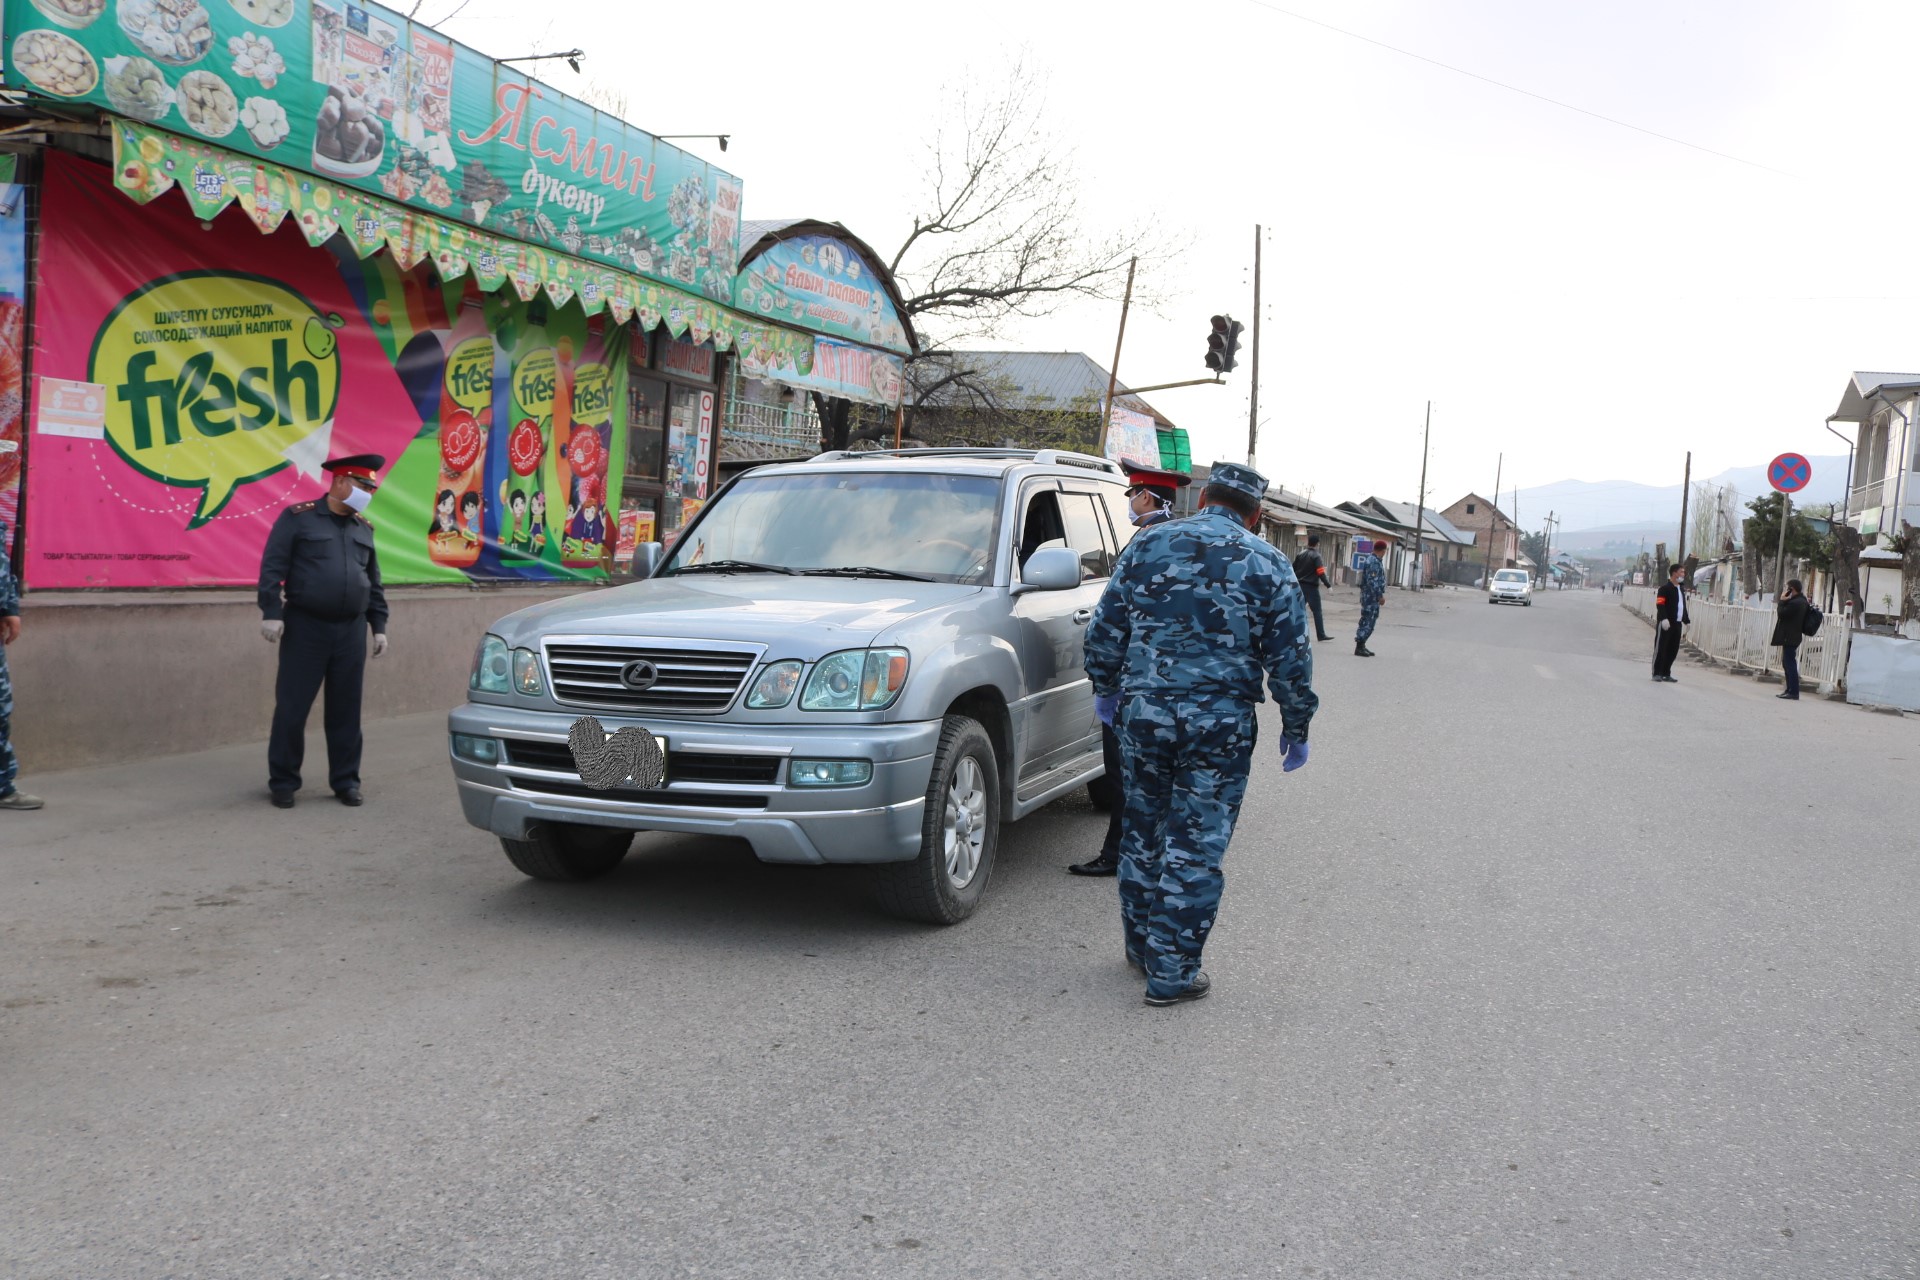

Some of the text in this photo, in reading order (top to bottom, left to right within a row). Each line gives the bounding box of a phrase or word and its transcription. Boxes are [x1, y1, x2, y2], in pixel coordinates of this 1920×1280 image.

[458, 83, 656, 201] Ясмин
[786, 264, 825, 293] Алым
[212, 303, 274, 321] СУУСУНДУК
[807, 303, 850, 326] кафеси
[134, 319, 292, 345] СОКОСОДЕРЖАЩИЙ НАПИТОК
[117, 338, 320, 450] fresh
[452, 364, 493, 397] fres
[519, 373, 555, 406] fres
[695, 395, 713, 499] ОПТОМ
[117, 553, 136, 561] ТОВАР
[1357, 556, 1366, 569] P
